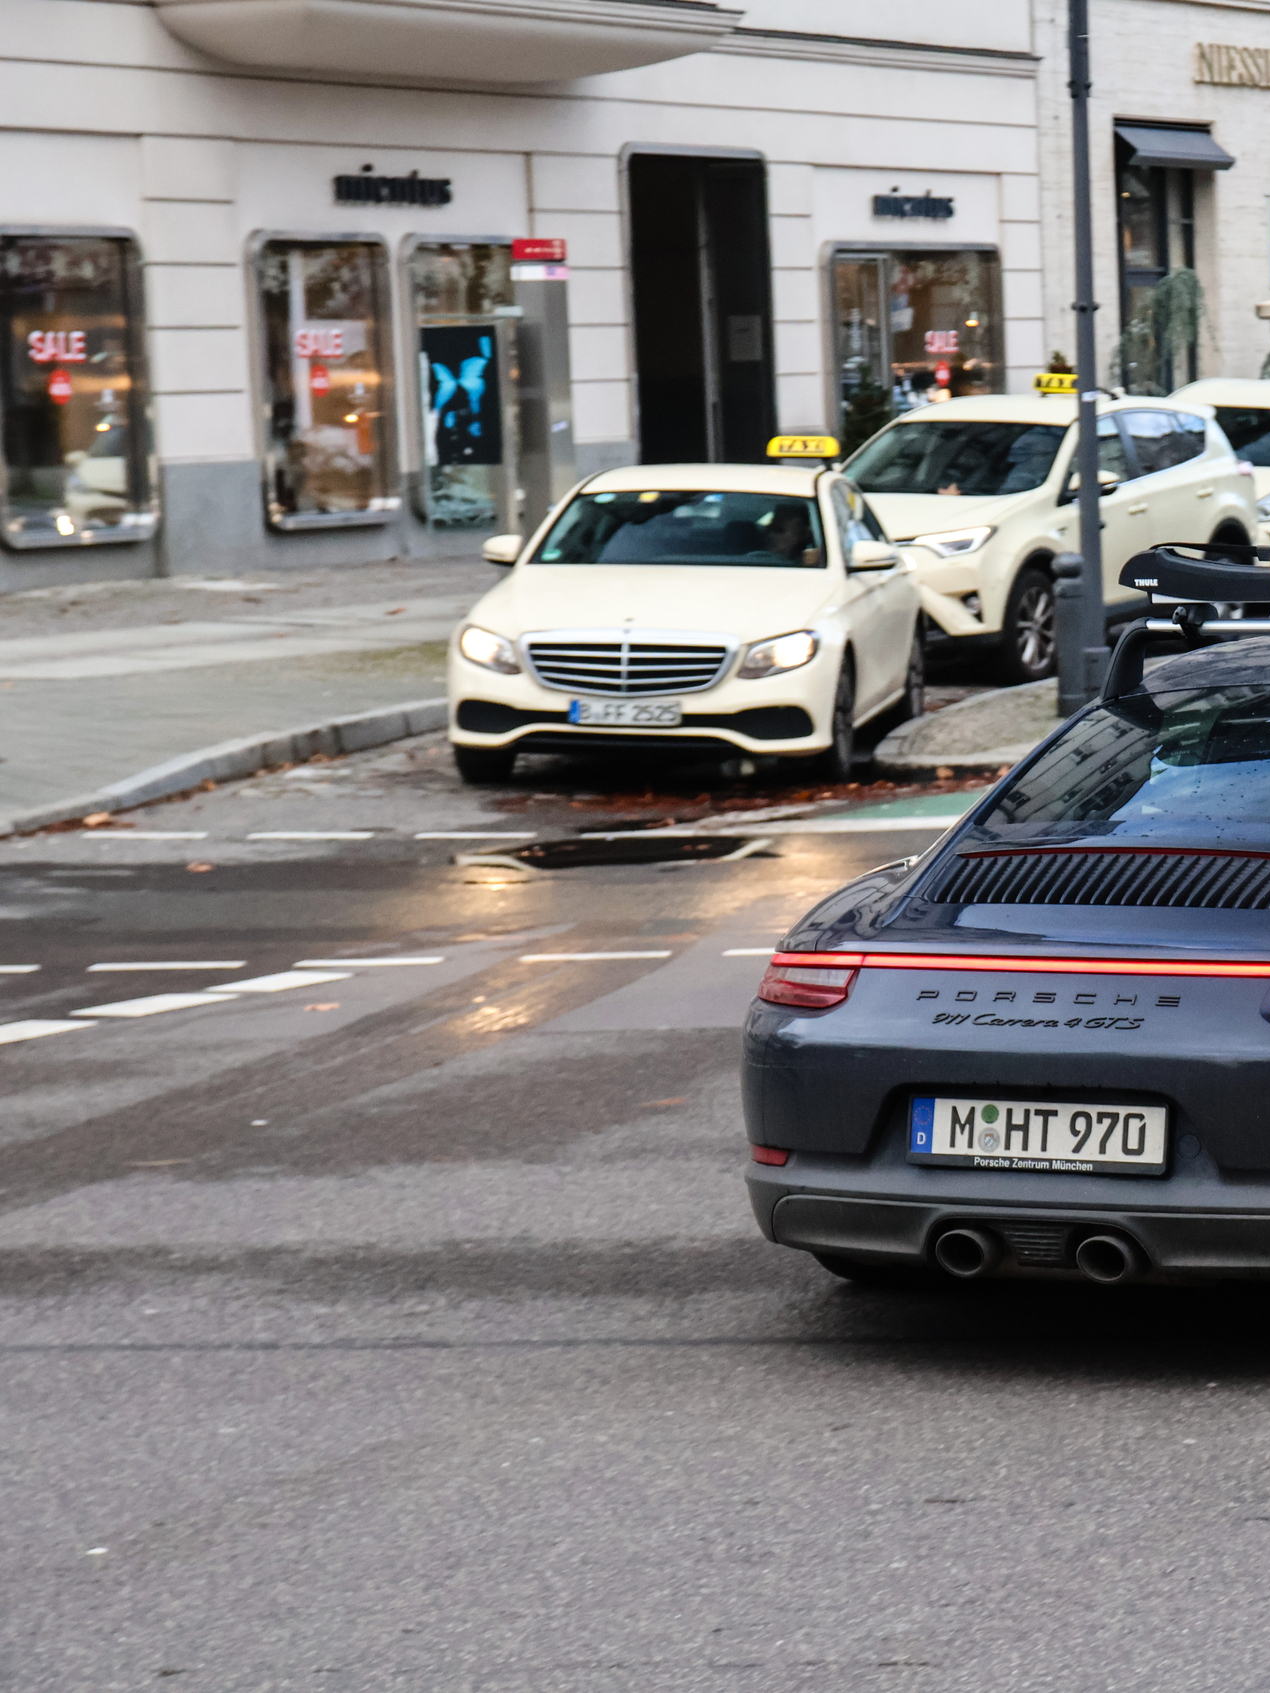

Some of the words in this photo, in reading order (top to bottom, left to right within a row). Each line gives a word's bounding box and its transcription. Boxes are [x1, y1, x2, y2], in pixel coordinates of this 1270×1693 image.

[28, 330, 87, 362] SALE
[295, 329, 343, 358] SALE
[1133, 578, 1159, 587] THULE
[580, 702, 591, 720] B
[603, 703, 627, 720] FF
[631, 702, 681, 722] 2525
[915, 989, 1182, 1008] PORSCHE
[931, 1012, 971, 1025] 911
[972, 1013, 1060, 1028] Carrera
[1083, 1017, 1145, 1030] GTS
[916, 1131, 927, 1145] D
[949, 1105, 976, 1150] M
[1003, 1107, 1059, 1152] HT
[1069, 1110, 1147, 1157] 970
[973, 1156, 1010, 1169] Porsche
[1012, 1157, 1050, 1170] Zentrum
[1051, 1158, 1094, 1172] München
